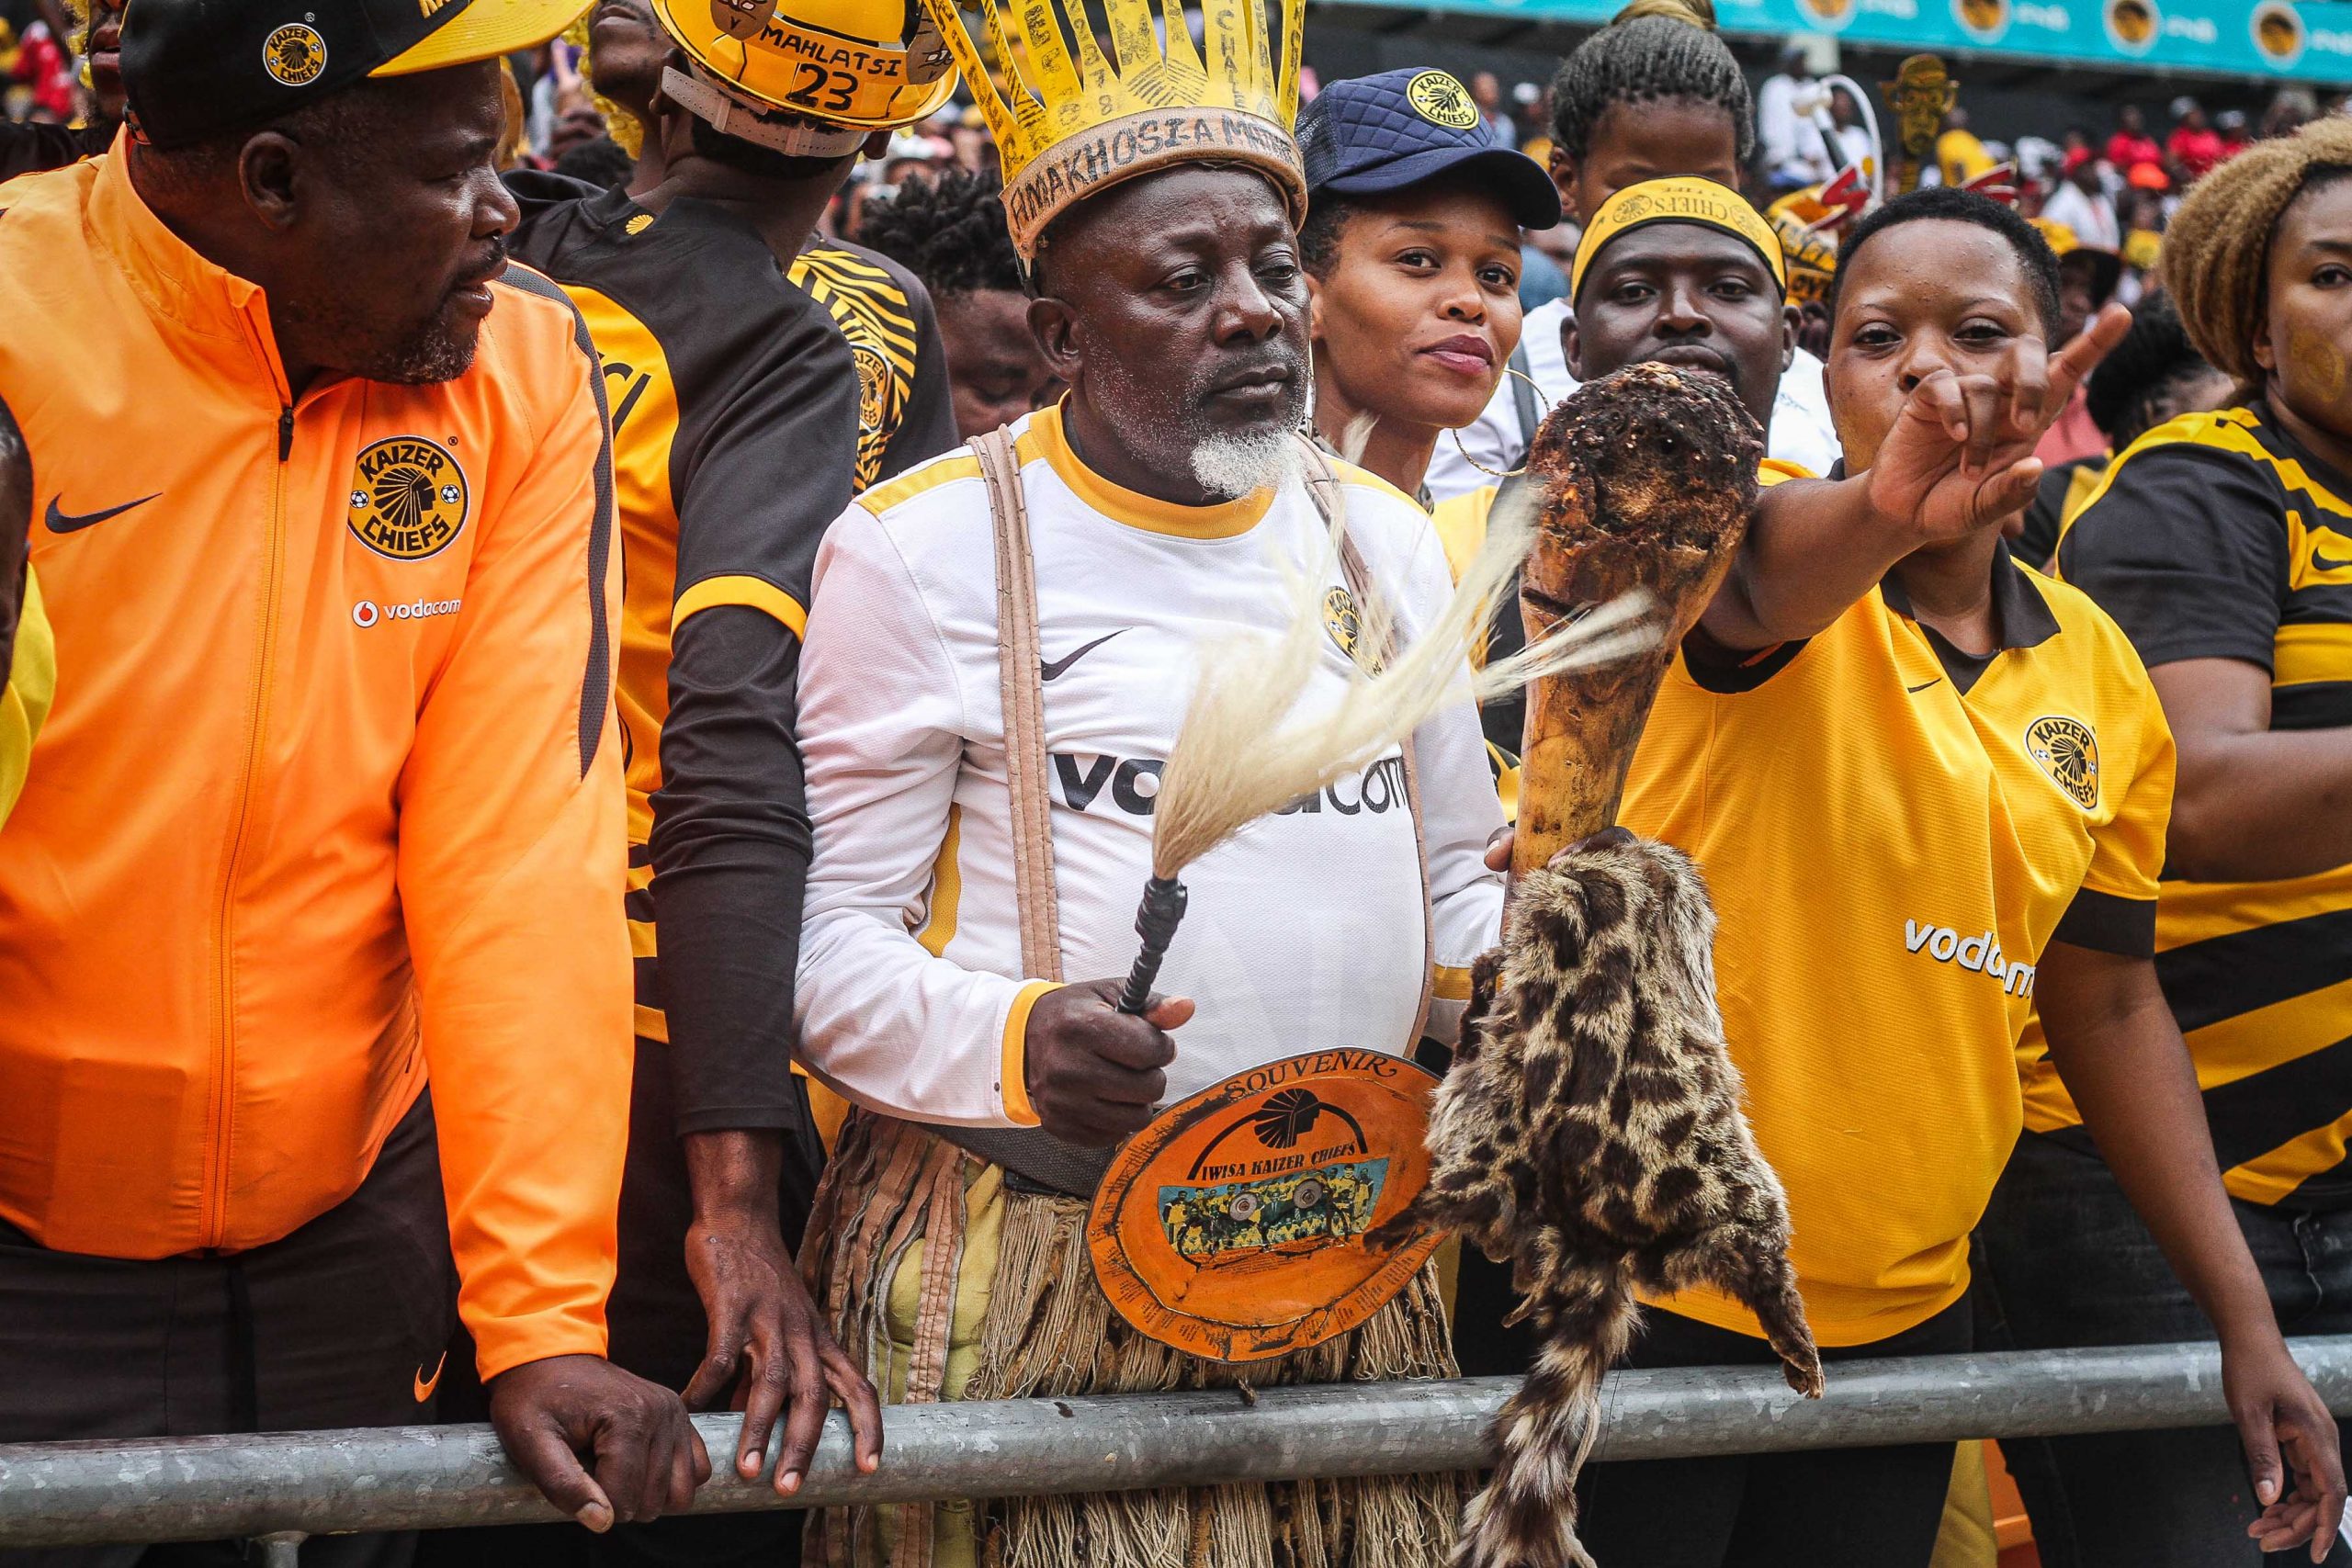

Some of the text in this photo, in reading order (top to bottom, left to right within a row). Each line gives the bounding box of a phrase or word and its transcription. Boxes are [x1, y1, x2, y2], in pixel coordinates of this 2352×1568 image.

[269, 28, 310, 52] KAIZER
[759, 25, 902, 76] MAHLATSI
[279, 58, 321, 82] CHIEFS
[786, 63, 858, 111] 23
[1417, 76, 1460, 94] KAIZER
[1428, 106, 1472, 124] CHIEFS
[1654, 197, 1728, 220] CHIEFS
[853, 353, 884, 384] AIZER
[359, 445, 445, 484] KAIZER
[363, 513, 450, 551] CHIEFS
[383, 598, 461, 622] vodacom
[2034, 721, 2090, 752] KAIZER
[1053, 752, 1409, 816] vocom
[2052, 766, 2095, 803] CHIEFS
[1224, 1050, 1398, 1100] SOUVENIR
[1202, 1142, 1356, 1181] IWISA KAIZER CHIEFS
